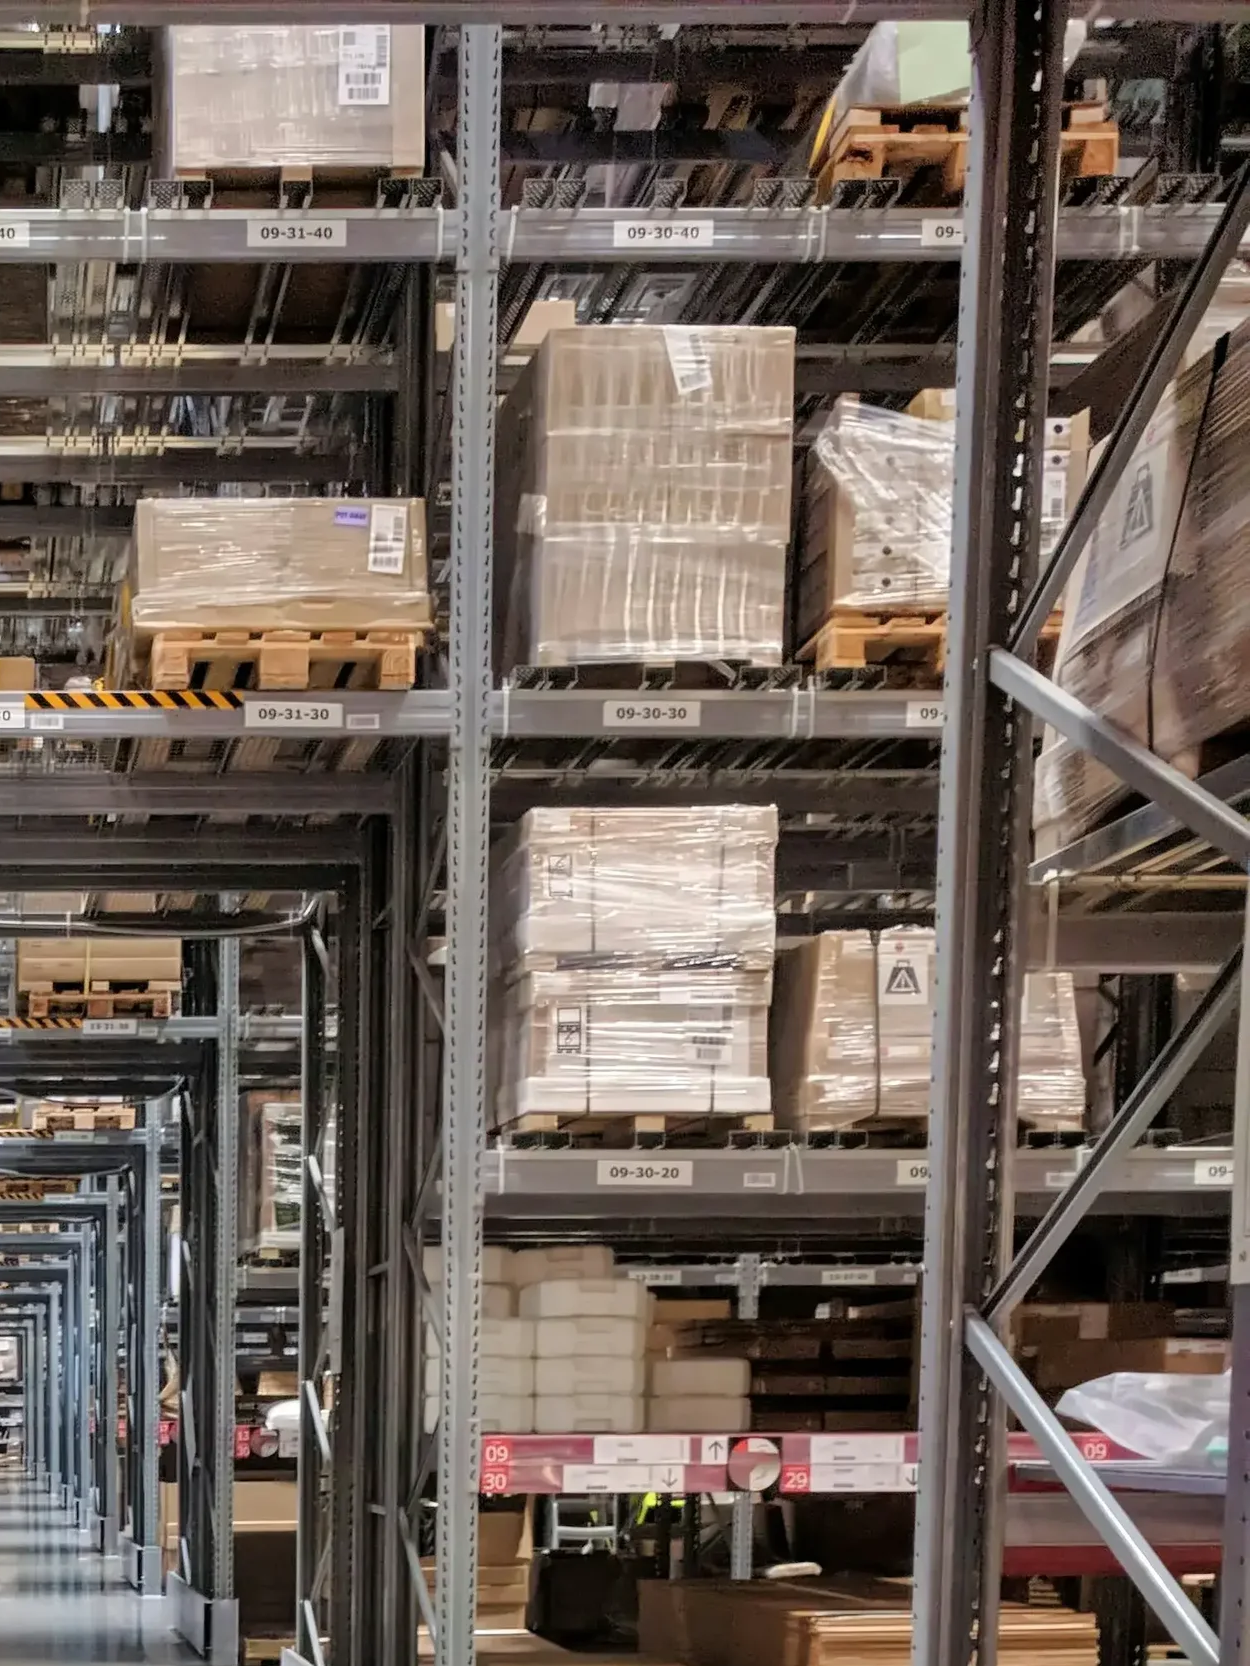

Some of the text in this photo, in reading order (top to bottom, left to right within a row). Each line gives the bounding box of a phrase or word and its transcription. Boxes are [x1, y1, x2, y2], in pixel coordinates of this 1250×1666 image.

[260, 227, 333, 240] 09-31-40
[627, 226, 700, 239] 09-30-40
[258, 708, 329, 720] 09-31-30
[616, 707, 687, 720] 09-30-30
[610, 1166, 680, 1179] 09-30-20
[485, 1445, 508, 1462] 09
[1084, 1443, 1107, 1459] 09
[484, 1474, 507, 1490] 30
[785, 1472, 808, 1488] 29
